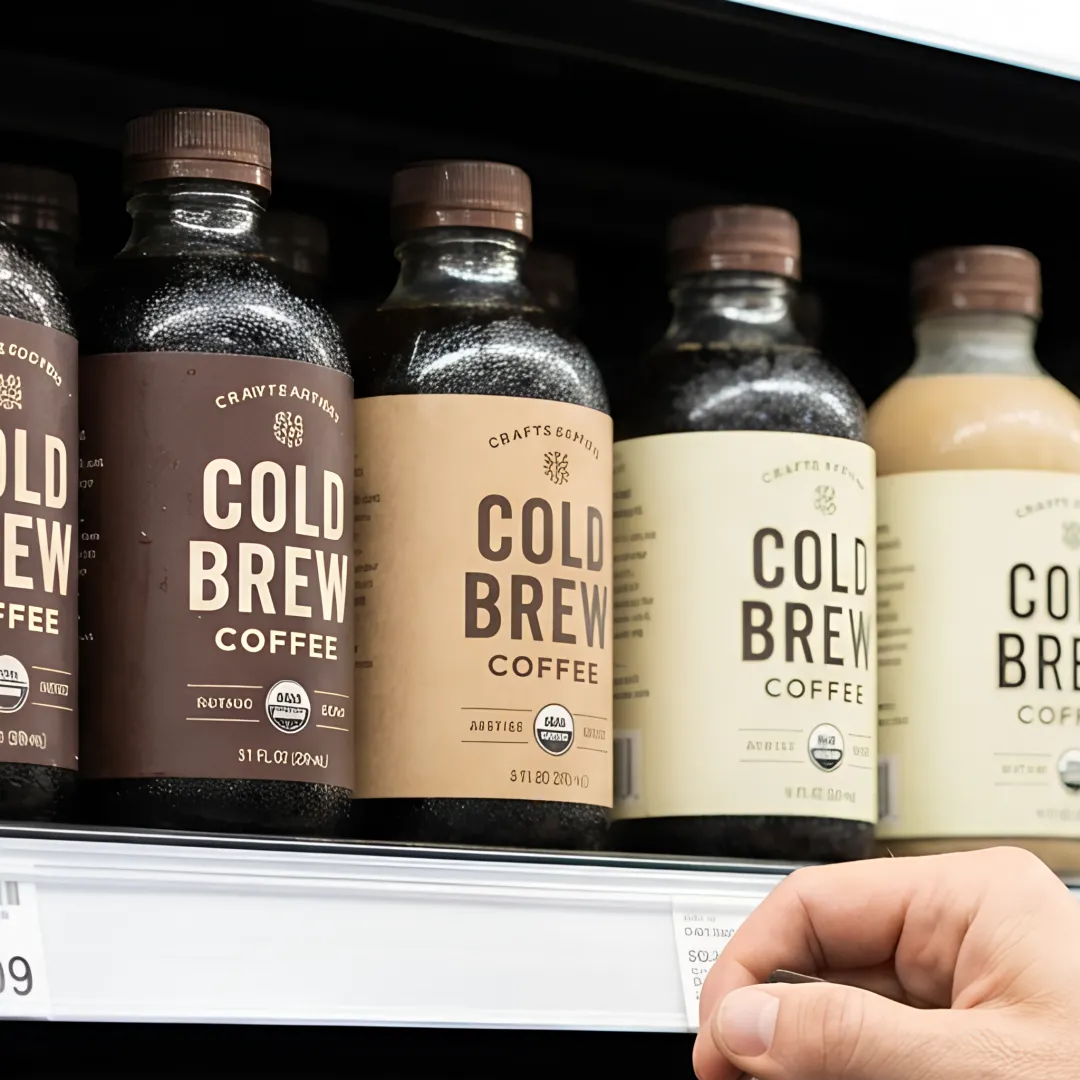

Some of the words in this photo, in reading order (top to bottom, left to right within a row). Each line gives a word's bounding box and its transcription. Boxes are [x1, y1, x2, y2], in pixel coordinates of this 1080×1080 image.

[0, 428, 67, 510] LD
[203, 458, 345, 541] COLD
[477, 493, 604, 572] COLD
[752, 526, 868, 597] COLD
[188, 540, 348, 624] BREW
[464, 571, 608, 650] BREW
[0, 601, 59, 635] FEE
[215, 627, 338, 661] COFFEE
[741, 600, 871, 671] BREW
[488, 654, 599, 685] COFFEE
[764, 678, 864, 705] COFFEE
[0, 955, 33, 996] 9
